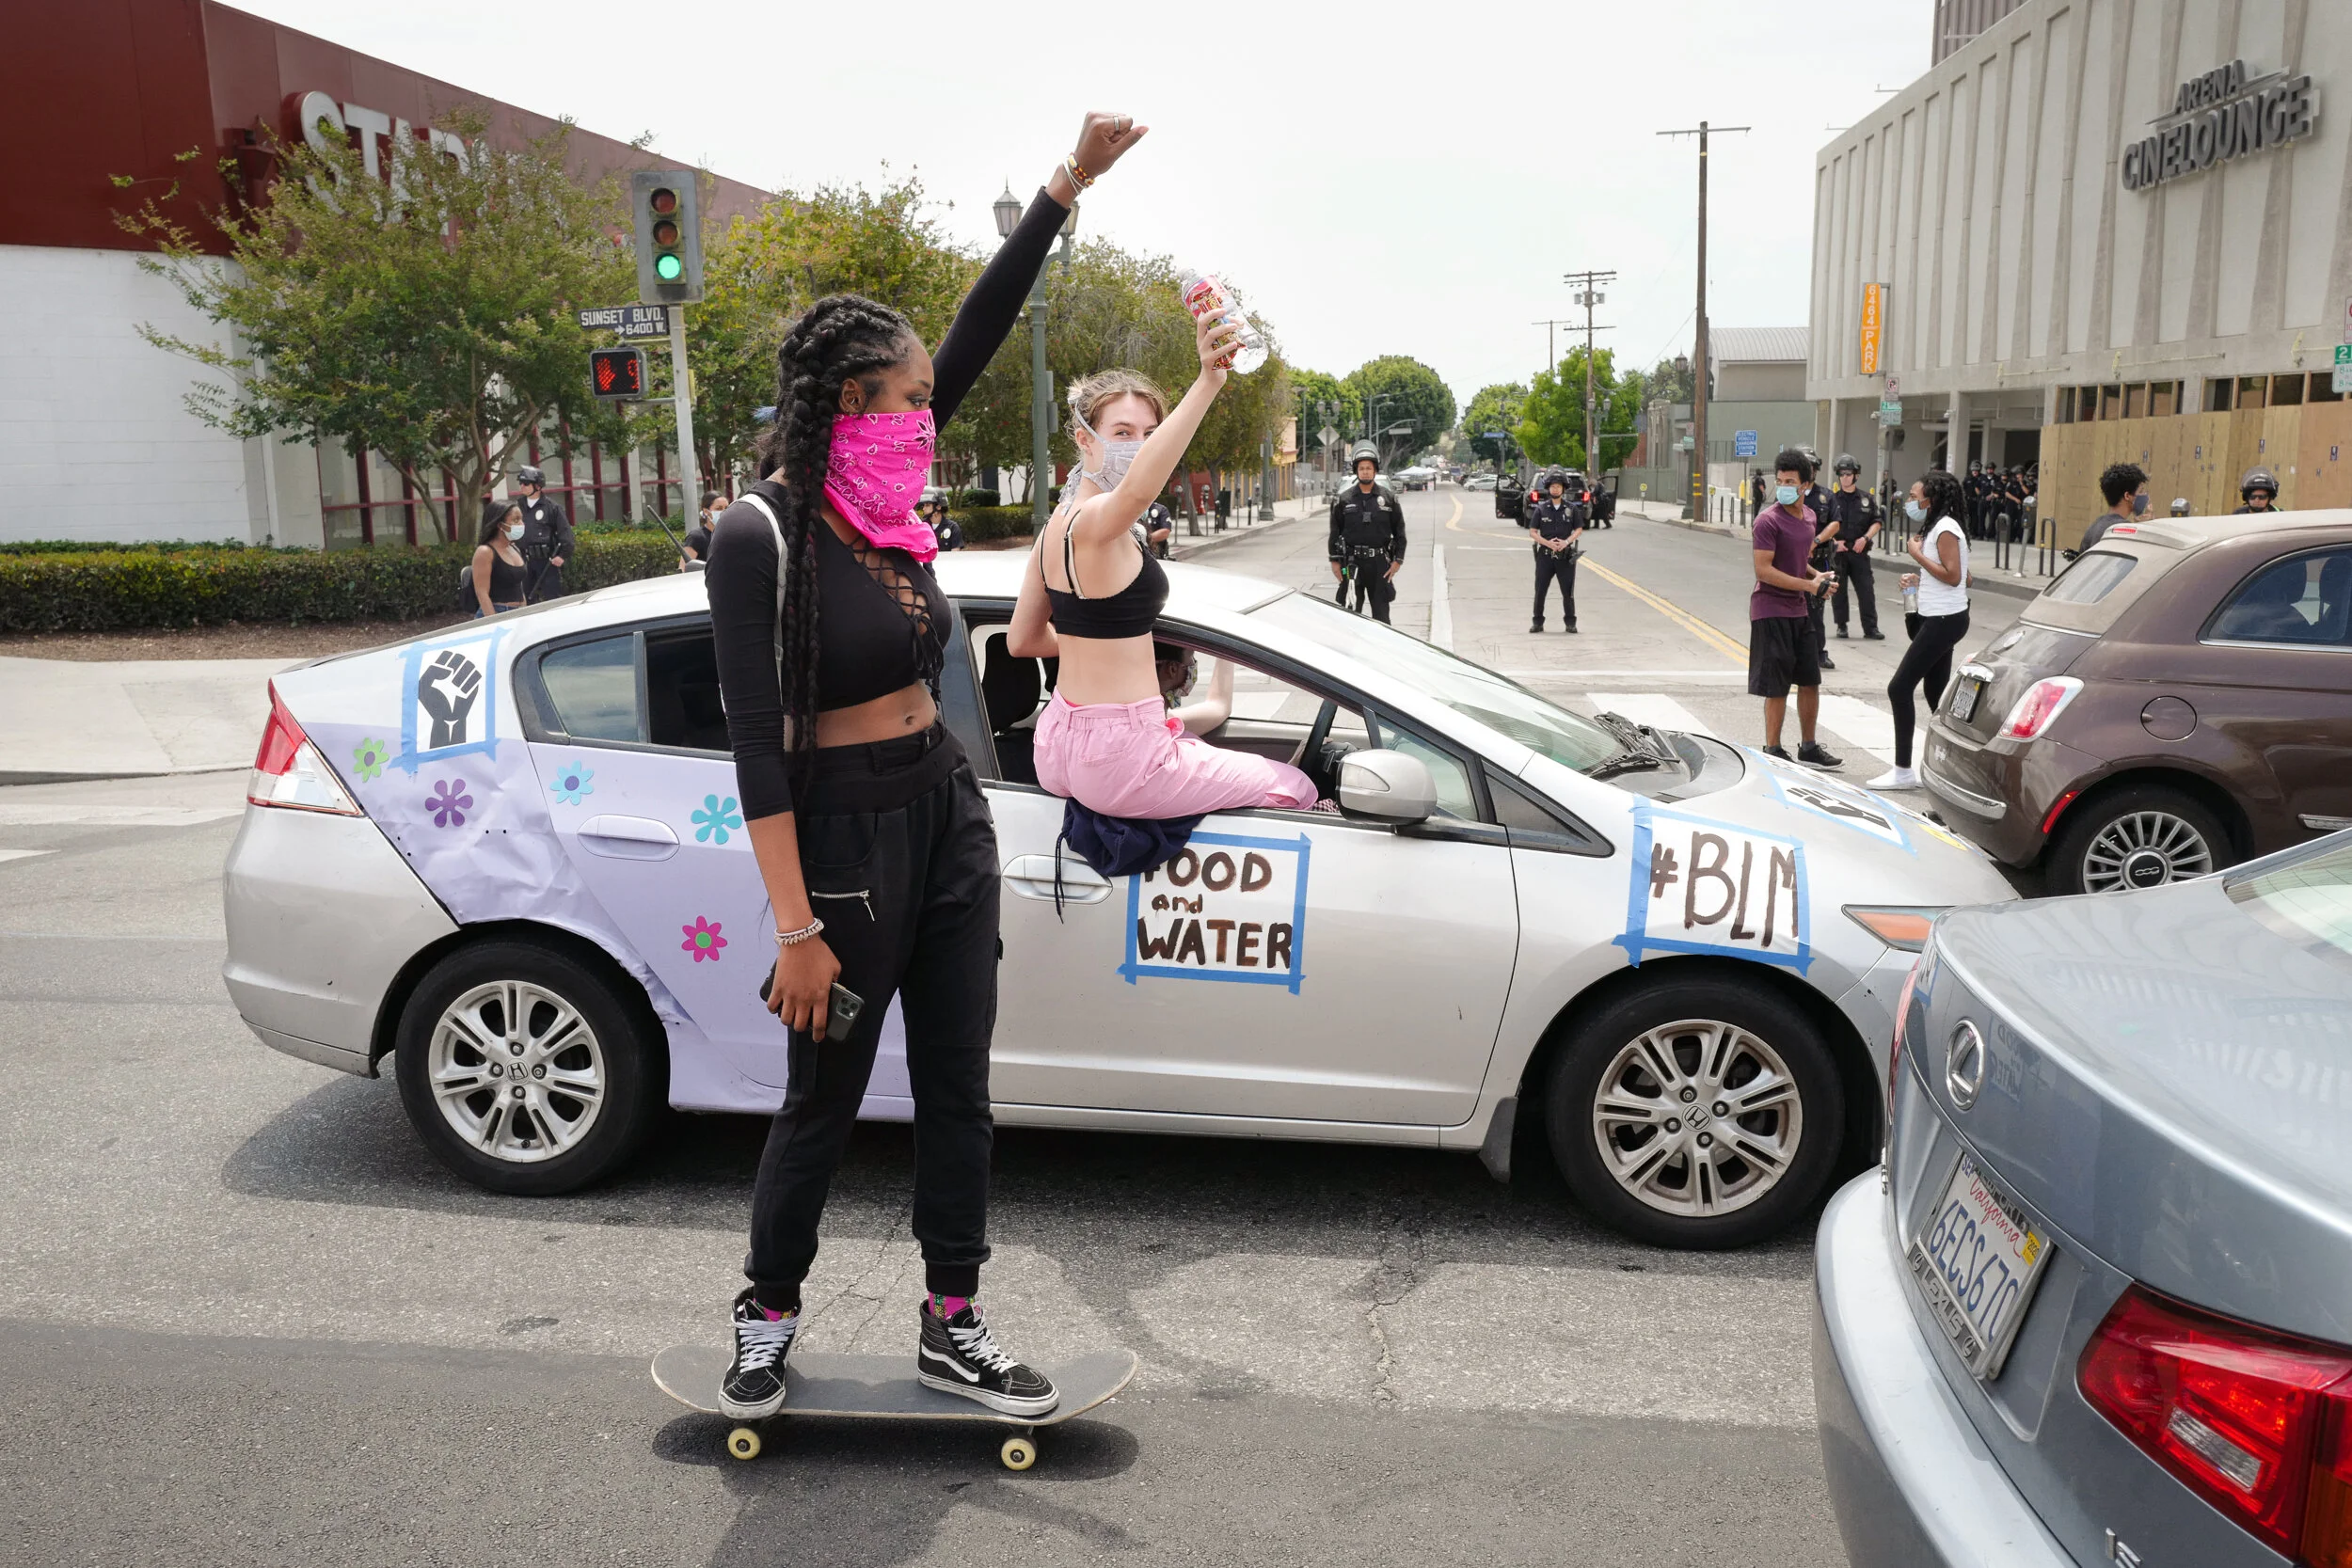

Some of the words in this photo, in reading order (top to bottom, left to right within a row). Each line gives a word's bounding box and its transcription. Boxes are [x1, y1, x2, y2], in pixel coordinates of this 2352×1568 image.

[2175, 59, 2246, 115] ARENA
[2122, 75, 2312, 190] CINELOUNGE
[580, 309, 625, 326] SUNSET
[632, 307, 664, 323] BLVD.
[626, 323, 654, 335] 6400
[656, 322, 666, 333] W.
[1867, 285, 1877, 325] 6464
[1864, 331, 1875, 372] PARK
[2339, 347, 2348, 359] 2
[1152, 894, 1203, 914] and
[1650, 831, 1799, 947] #BLM
[1136, 916, 1293, 969] WATER
[1970, 1177, 2021, 1259] California
[1922, 1264, 1965, 1339] LEXUS
